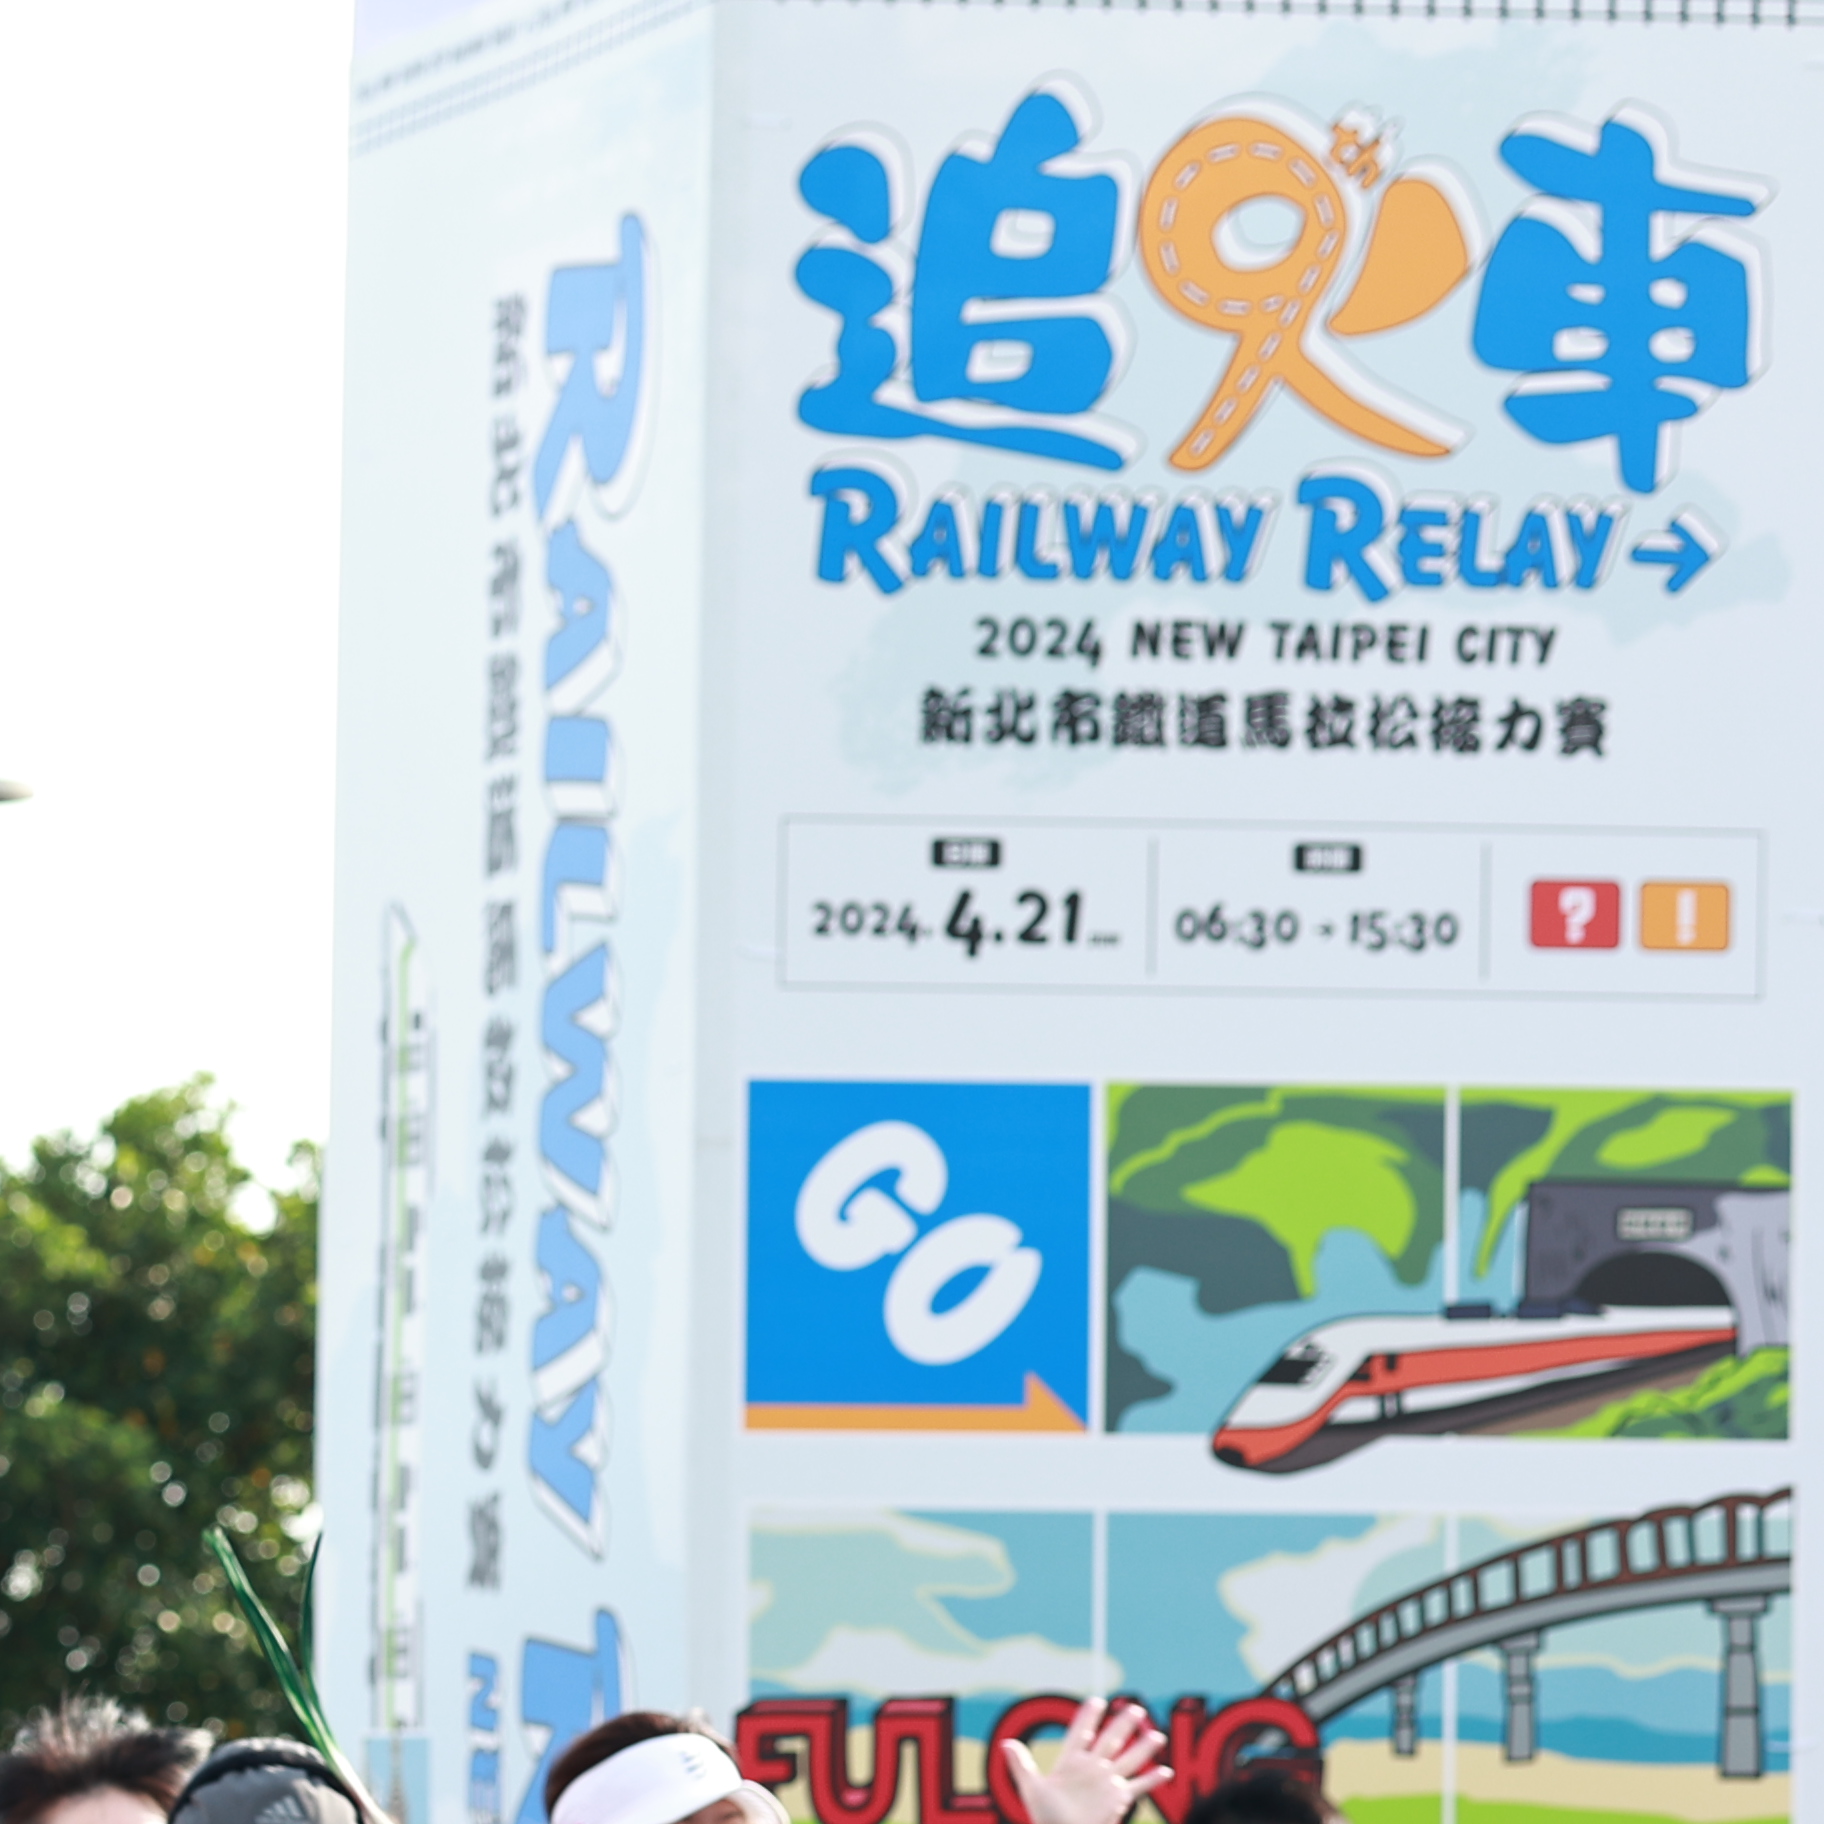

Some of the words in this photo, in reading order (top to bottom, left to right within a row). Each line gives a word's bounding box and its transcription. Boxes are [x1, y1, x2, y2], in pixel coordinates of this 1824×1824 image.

[809, 467, 1266, 596] RAILWAY
[1296, 472, 1617, 602] RELAY
[977, 618, 1104, 668] 2024
[1132, 620, 1246, 662] NEW
[1272, 621, 1432, 665] TAIPEI
[1456, 626, 1560, 668] CITY
[530, 209, 646, 1525] RAILWAY
[1175, 904, 1299, 949] 06:30
[1349, 910, 1459, 952] 15:30
[795, 1120, 1042, 1366] GO
